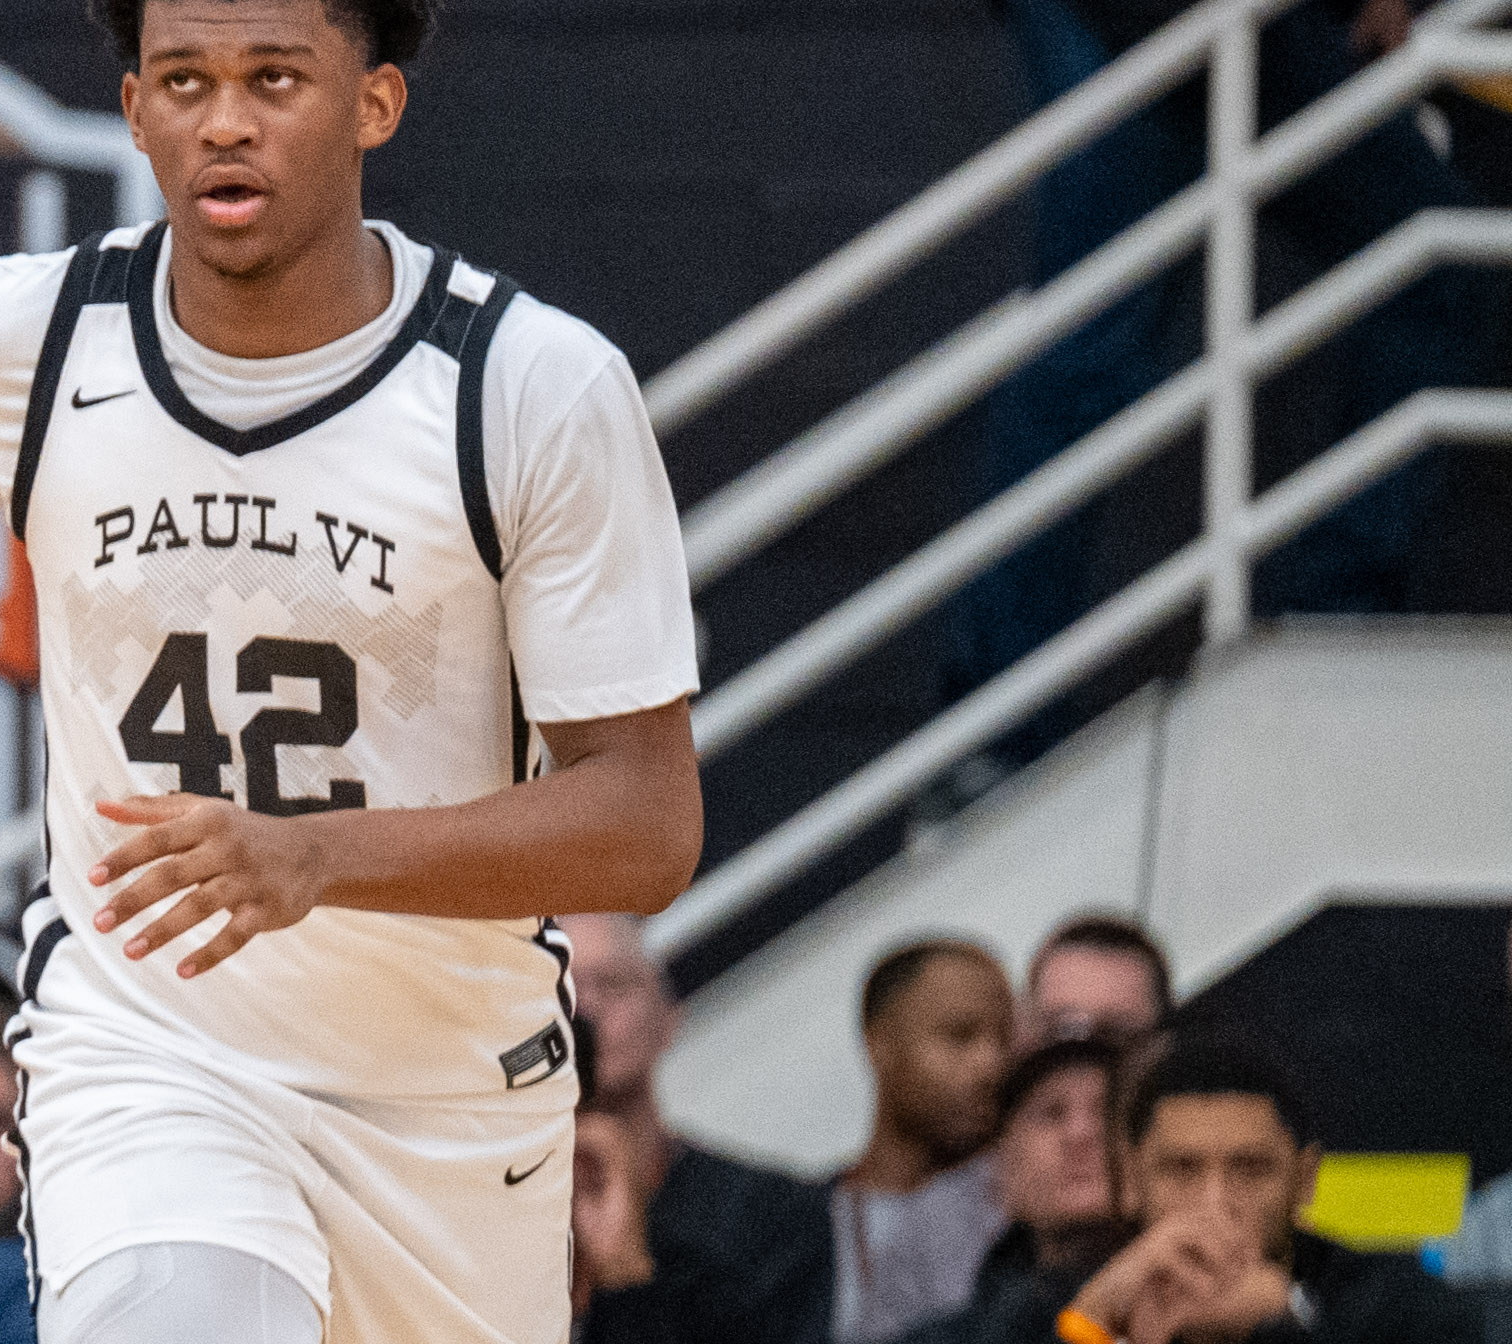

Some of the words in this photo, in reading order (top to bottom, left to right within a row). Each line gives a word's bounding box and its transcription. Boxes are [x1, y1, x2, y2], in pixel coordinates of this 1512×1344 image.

[94, 493, 297, 568] PAUL
[315, 511, 396, 594] VI
[118, 632, 367, 817] 42
